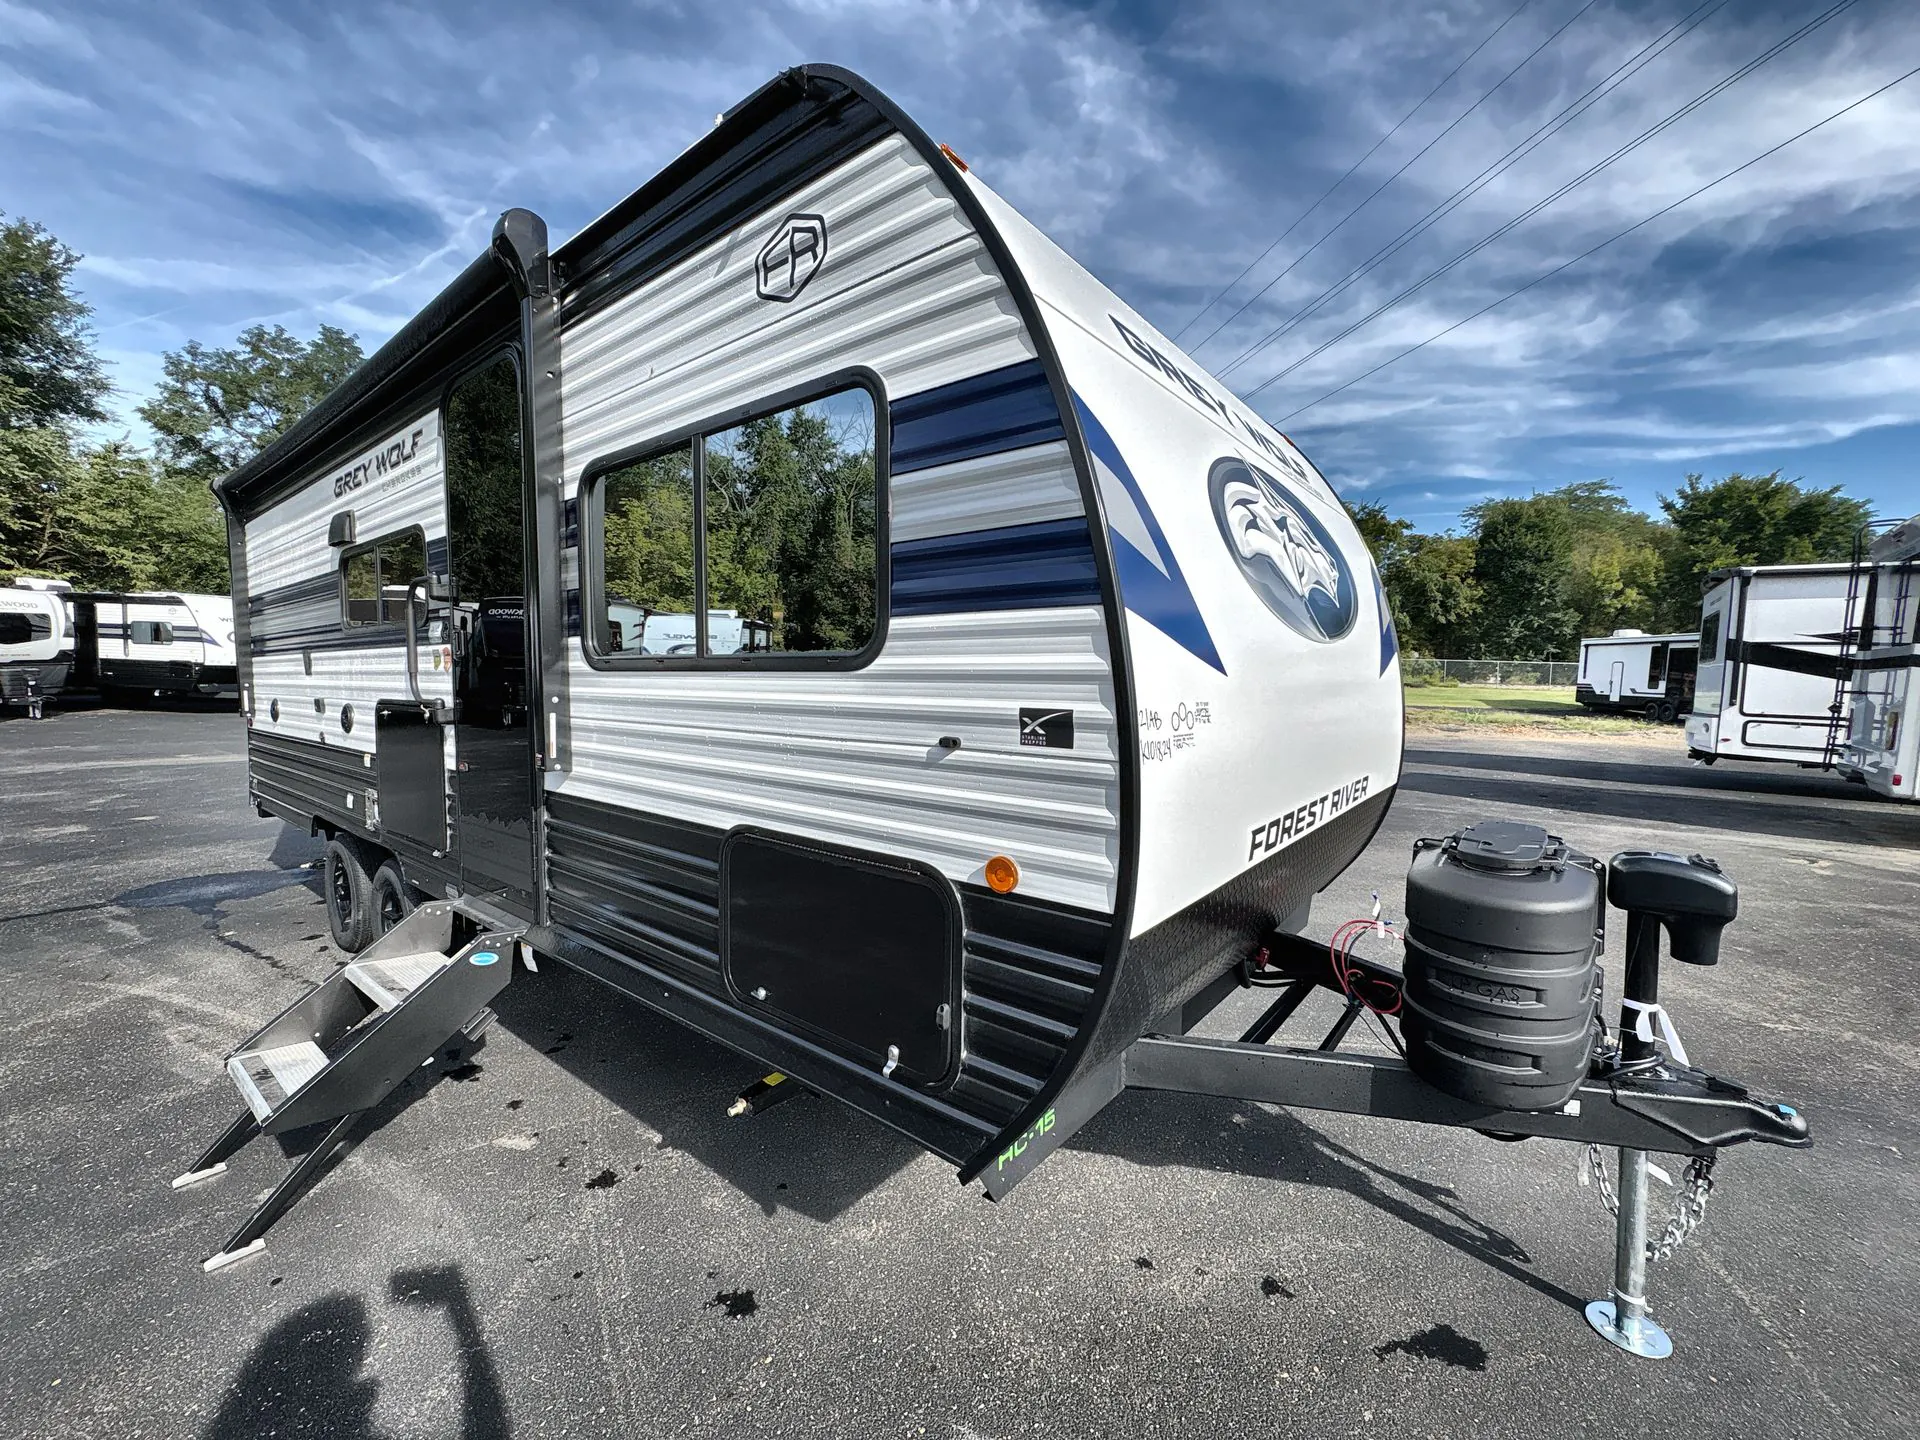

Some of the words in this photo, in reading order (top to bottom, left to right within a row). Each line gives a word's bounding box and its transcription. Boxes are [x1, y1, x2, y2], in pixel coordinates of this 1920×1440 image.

[1108, 313, 1236, 428] GREY
[1232, 411, 1310, 484] WOLF
[333, 458, 373, 499] GREY
[375, 427, 424, 477] WOLF
[1248, 794, 1329, 862] FOREST
[1330, 775, 1369, 816] RIVER
[1476, 982, 1520, 1001] GAS
